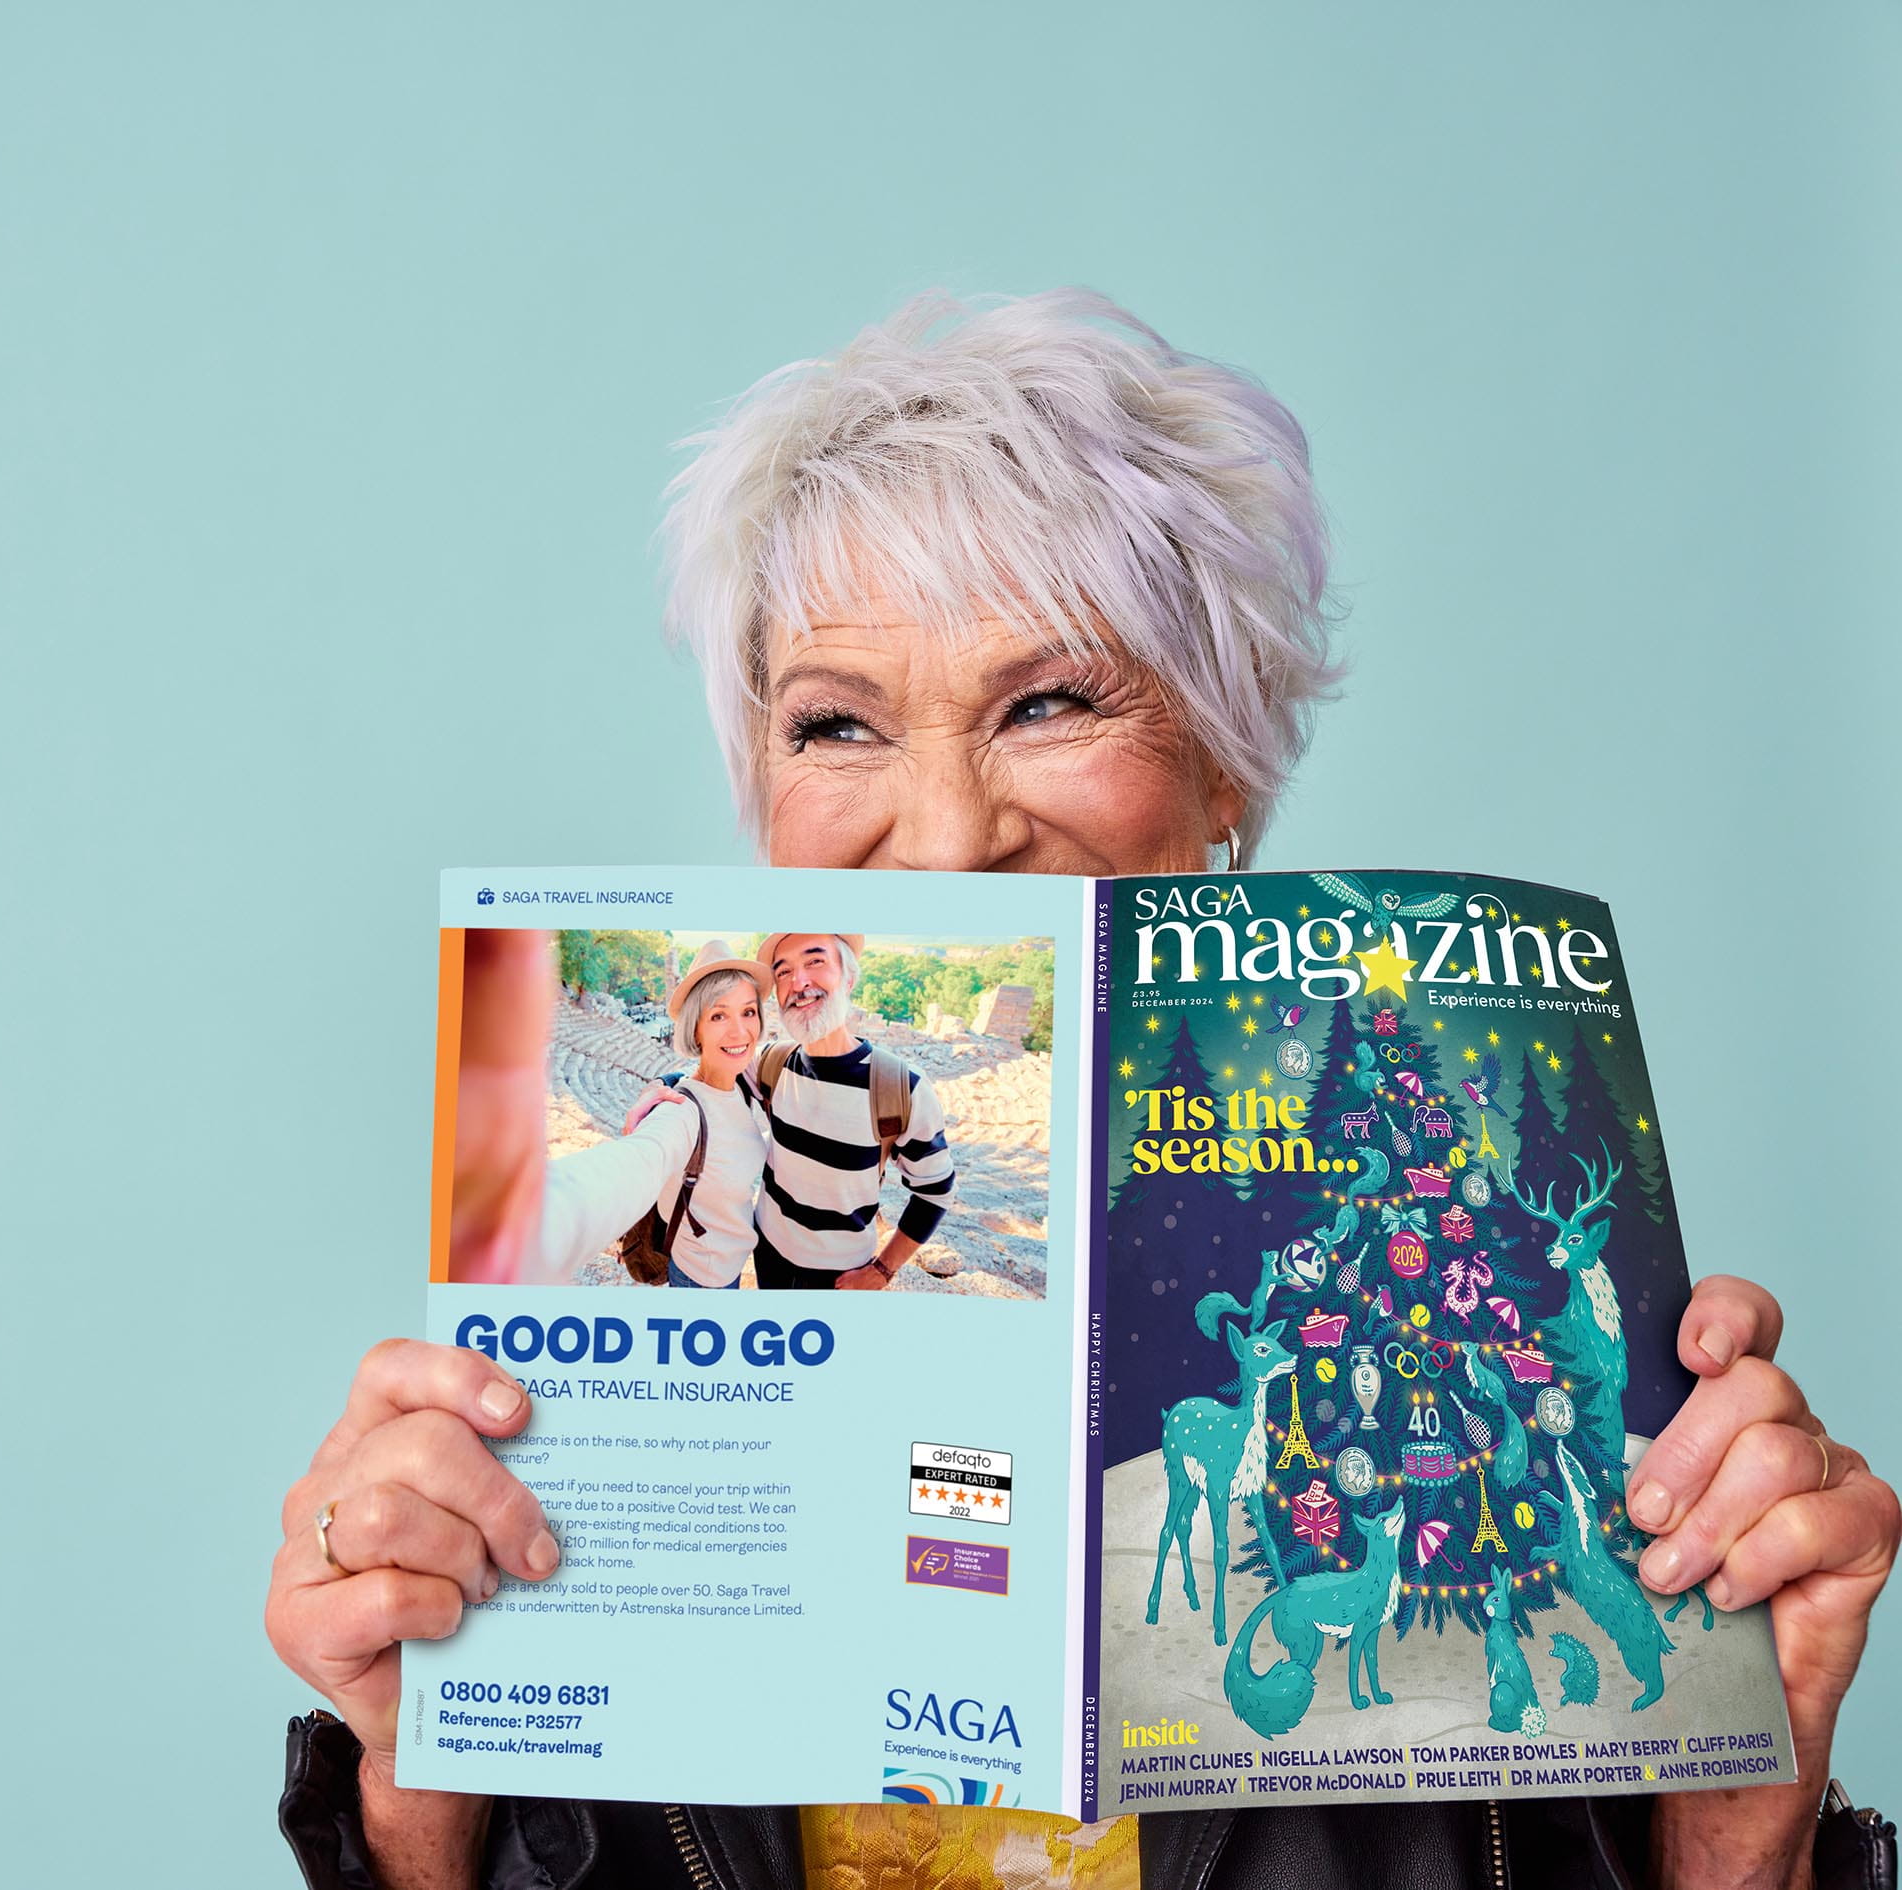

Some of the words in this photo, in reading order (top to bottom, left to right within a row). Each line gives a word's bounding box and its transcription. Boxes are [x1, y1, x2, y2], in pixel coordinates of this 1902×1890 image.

[502, 891, 541, 904] SAGA
[543, 891, 594, 904] TRAVEL
[596, 891, 674, 905] INSURANCE
[1134, 884, 1254, 921] SAGA
[1098, 903, 1109, 938] SAGA
[1134, 893, 1613, 1001] magazine
[1097, 943, 1108, 1013] MAGAZINE
[1131, 998, 1187, 1008] DECEMBER
[1190, 997, 1214, 1007] 2024
[1132, 990, 1161, 999] £3.95
[1427, 989, 1516, 1009] Experience
[1519, 994, 1533, 1010] is
[1537, 997, 1622, 1019] everything
[1226, 1087, 1307, 1131] the
[1131, 1136, 1359, 1175] season...
[1393, 1245, 1424, 1267] 2024
[455, 1313, 634, 1364] GOOD
[647, 1318, 726, 1367] TO
[740, 1319, 835, 1367] GO
[1091, 1313, 1101, 1355] HAPPY
[578, 1380, 659, 1400] TRAVEL
[664, 1381, 794, 1402] INSURANCE
[1090, 1361, 1100, 1436] CHRISTMAS
[1408, 1406, 1441, 1437] 40
[561, 1434, 571, 1446] is
[573, 1437, 589, 1447] on
[592, 1435, 612, 1447] the
[615, 1436, 641, 1449] rise,
[644, 1438, 658, 1448] so
[661, 1437, 685, 1452] why
[688, 1438, 710, 1450] not
[712, 1438, 739, 1453] plan
[742, 1440, 771, 1454] your
[494, 1452, 549, 1464] venture?
[932, 1448, 992, 1470] defaqto
[522, 1479, 564, 1491] overed
[567, 1479, 576, 1491] if
[577, 1482, 599, 1495] you
[602, 1481, 633, 1493] need
[636, 1482, 650, 1493] to
[652, 1483, 692, 1495] cancel
[694, 1485, 724, 1498] your
[727, 1483, 750, 1498] trip
[753, 1482, 791, 1495] within
[925, 1469, 963, 1482] EXPERT
[965, 1473, 997, 1487] RATED
[539, 1499, 571, 1510] rture
[575, 1499, 598, 1511] due
[601, 1500, 615, 1511] to
[616, 1502, 624, 1512] a
[627, 1500, 675, 1514] positive
[678, 1501, 715, 1515] Covid
[717, 1502, 746, 1515] test.
[749, 1502, 770, 1514] We
[772, 1503, 796, 1514] can
[949, 1505, 971, 1517] 2022
[547, 1519, 563, 1532] ny
[565, 1519, 640, 1533] pre-existing
[643, 1520, 691, 1533] medical
[694, 1521, 760, 1534] conditions
[763, 1522, 787, 1533] too.
[563, 1536, 586, 1548] £10
[589, 1537, 629, 1550] million
[632, 1537, 650, 1550] for
[653, 1540, 702, 1552] medical
[705, 1540, 787, 1555] emergencies
[954, 1547, 990, 1558] Insurance
[565, 1555, 594, 1567] back
[598, 1555, 635, 1569] home.
[954, 1554, 979, 1563] Choice
[954, 1562, 981, 1571] Awards
[519, 1582, 540, 1593] are
[543, 1582, 568, 1595] only
[571, 1582, 597, 1594] sold
[600, 1583, 613, 1594] to
[616, 1583, 658, 1598] people
[661, 1586, 690, 1596] over
[693, 1584, 713, 1597] 50.
[716, 1584, 748, 1600] Saga
[751, 1584, 790, 1597] Travel
[463, 1601, 503, 1611] urance
[506, 1600, 516, 1611] is
[519, 1600, 600, 1613] underwritten
[602, 1602, 617, 1616] by
[620, 1602, 685, 1615] Astrenska
[688, 1603, 751, 1616] Insurance
[754, 1603, 805, 1616] Limited.
[440, 1680, 502, 1703] 0800
[508, 1684, 551, 1705] 409
[558, 1685, 609, 1706] 6831
[439, 1710, 522, 1728] Reference:
[525, 1714, 582, 1730] P32577
[886, 1689, 1022, 1748] SAGA
[1085, 1697, 1096, 1766] DECEMBER
[1122, 1718, 1200, 1748] inside
[437, 1737, 603, 1758] saga.co.uk/travelmag
[884, 1740, 947, 1760] Experience
[949, 1749, 959, 1762] is
[960, 1754, 1022, 1775] everything
[1121, 1754, 1185, 1774] MARTIN
[1189, 1752, 1253, 1771] CLUNES
[1261, 1750, 1330, 1767] NIGELLA
[1334, 1748, 1404, 1766] LAWSON
[1410, 1746, 1447, 1763] TOM
[1450, 1745, 1509, 1763] PARKER
[1513, 1743, 1577, 1761] BOWLES
[1585, 1742, 1629, 1759] MARY
[1632, 1739, 1679, 1756] BERRY
[1687, 1736, 1726, 1754] CLIFF
[1728, 1732, 1774, 1750] PARISI
[1085, 1772, 1094, 1802] 2024
[1119, 1782, 1164, 1804] JENNI
[1168, 1777, 1237, 1797] MURRAY
[1248, 1775, 1312, 1793] TREVOR
[1316, 1773, 1406, 1791] McDONALD
[1416, 1772, 1456, 1788] PRUE
[1459, 1771, 1501, 1787] LEITH
[1511, 1770, 1533, 1786] DR
[1536, 1768, 1582, 1785] MARK
[1584, 1766, 1643, 1784] PORTER
[1644, 1764, 1657, 1781] &
[1659, 1762, 1699, 1780] ANNE
[1702, 1756, 1779, 1777] ROBINSON
